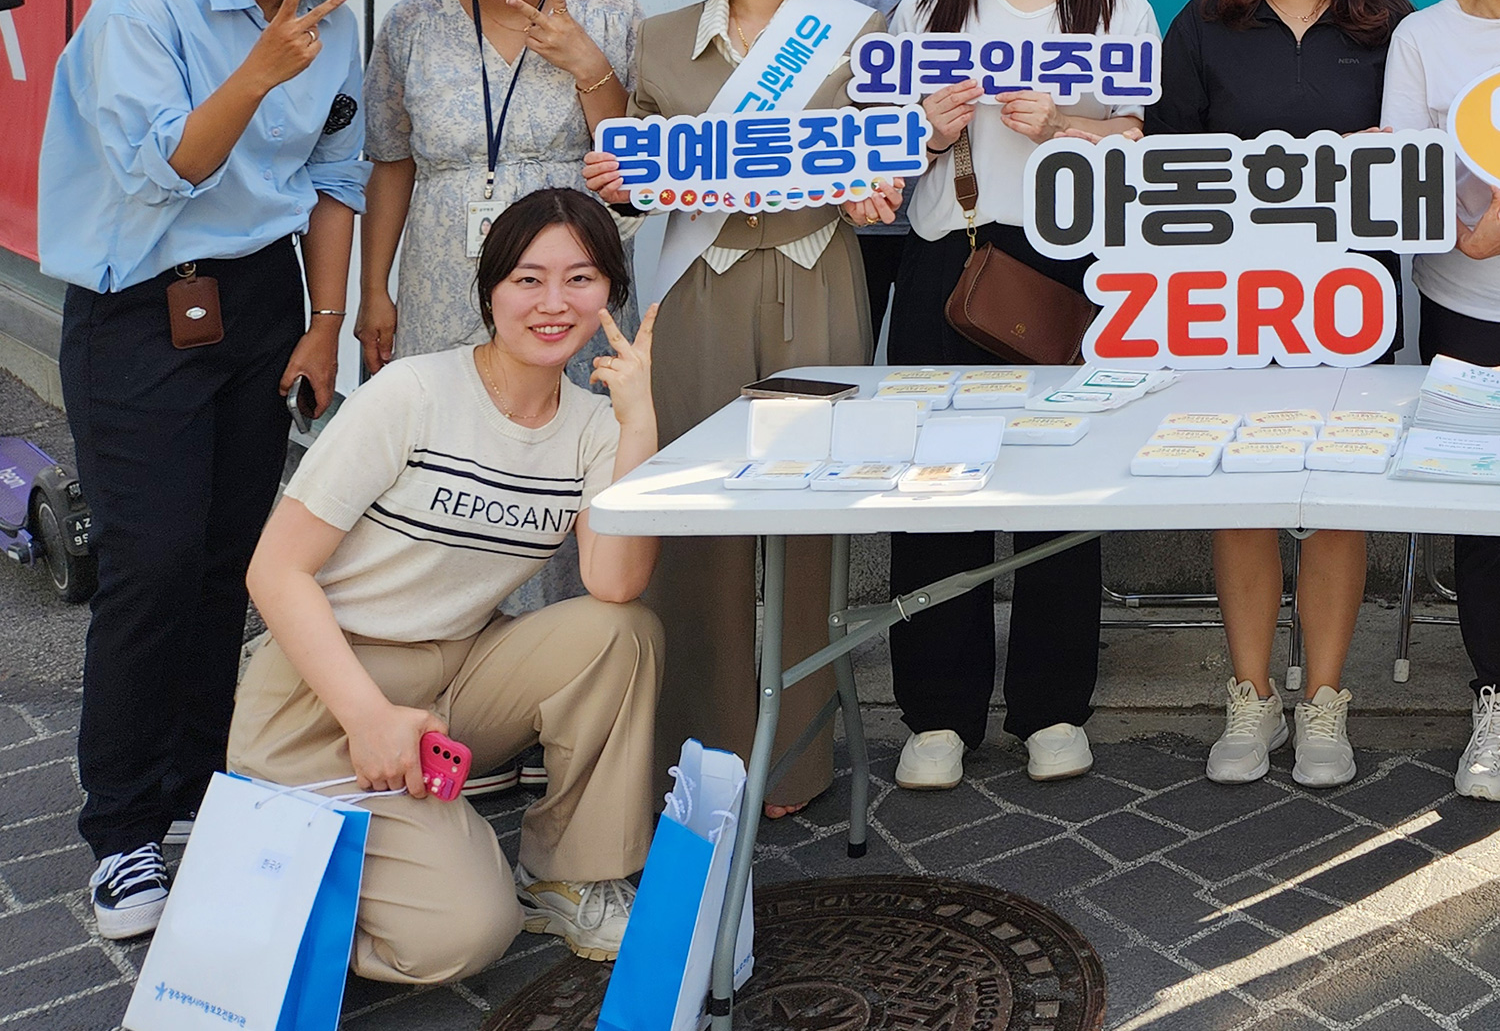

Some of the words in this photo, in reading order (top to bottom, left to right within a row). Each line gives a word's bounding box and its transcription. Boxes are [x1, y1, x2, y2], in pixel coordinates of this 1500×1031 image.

[856, 39, 1156, 98] 외국인주민
[601, 111, 926, 183] 명예통장단
[1034, 142, 1446, 248] 아동학대
[1093, 267, 1385, 359] ZERO
[428, 486, 578, 534] REPOSANT
